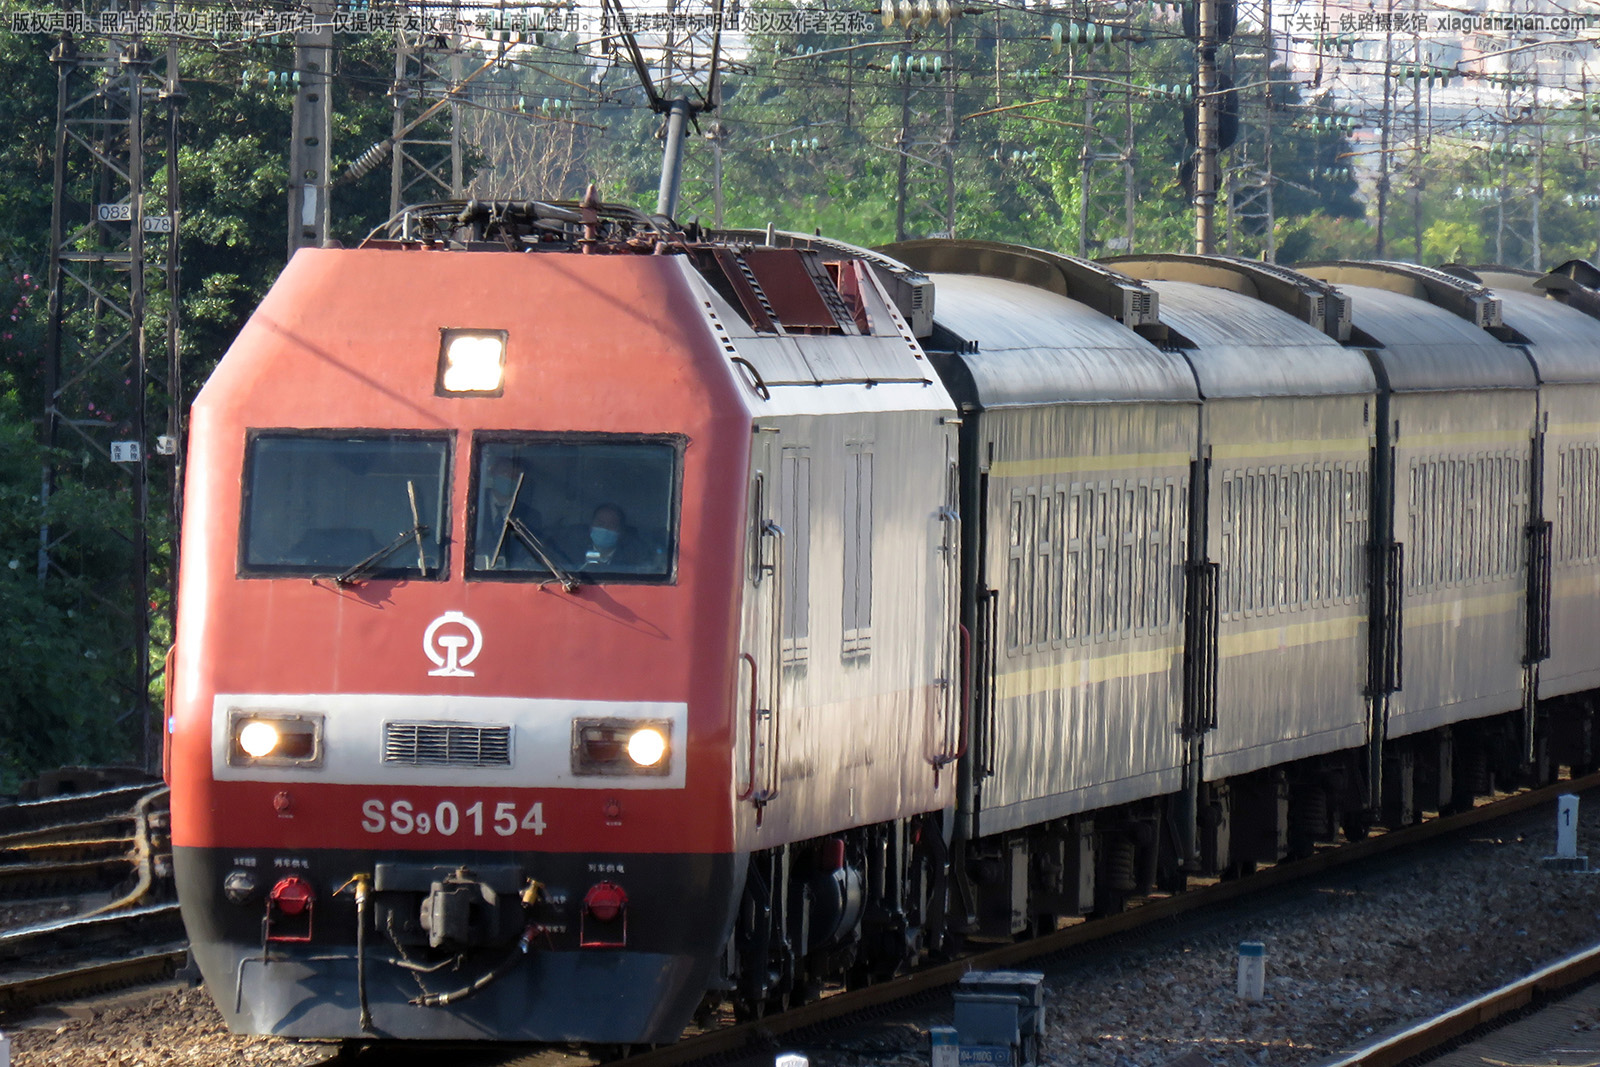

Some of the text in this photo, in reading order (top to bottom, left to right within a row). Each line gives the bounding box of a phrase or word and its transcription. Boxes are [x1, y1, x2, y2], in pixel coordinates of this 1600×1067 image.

[100, 205, 130, 220] 082
[143, 218, 169, 231] 078
[1563, 808, 1570, 826] 1
